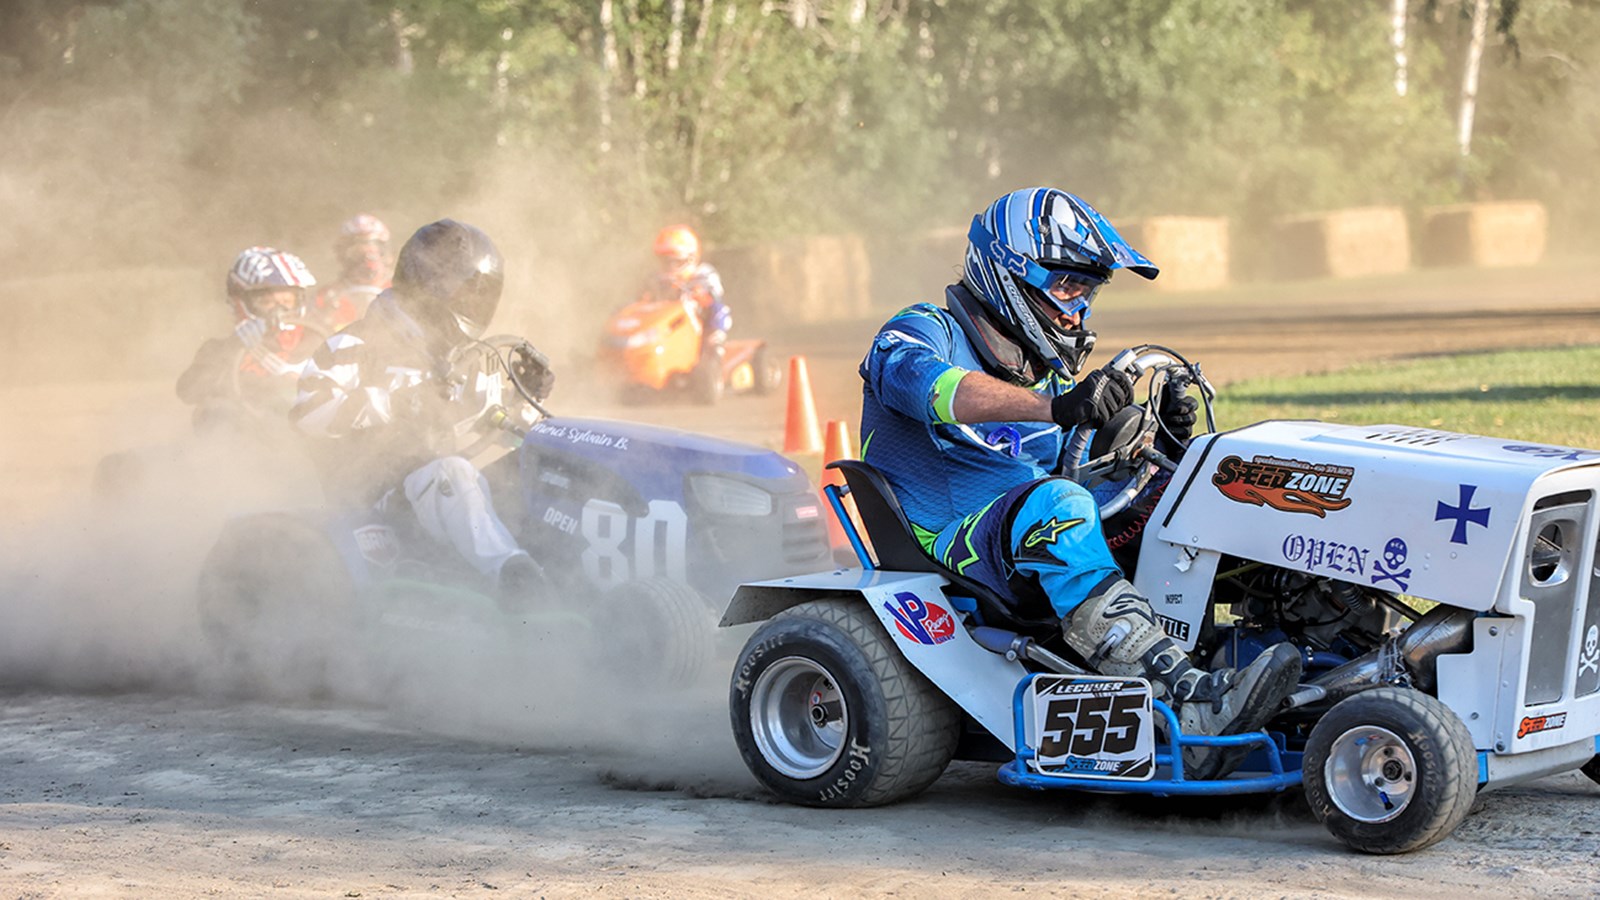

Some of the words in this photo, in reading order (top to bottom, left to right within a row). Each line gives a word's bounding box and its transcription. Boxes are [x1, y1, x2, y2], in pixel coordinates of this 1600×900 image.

[567, 427, 612, 446] Sylvain
[543, 506, 578, 535] OPEN
[581, 498, 687, 588] 80
[1283, 534, 1370, 576] OPEN
[883, 591, 934, 645] VP
[1056, 682, 1124, 694] LECUYER
[1040, 695, 1146, 758] 555
